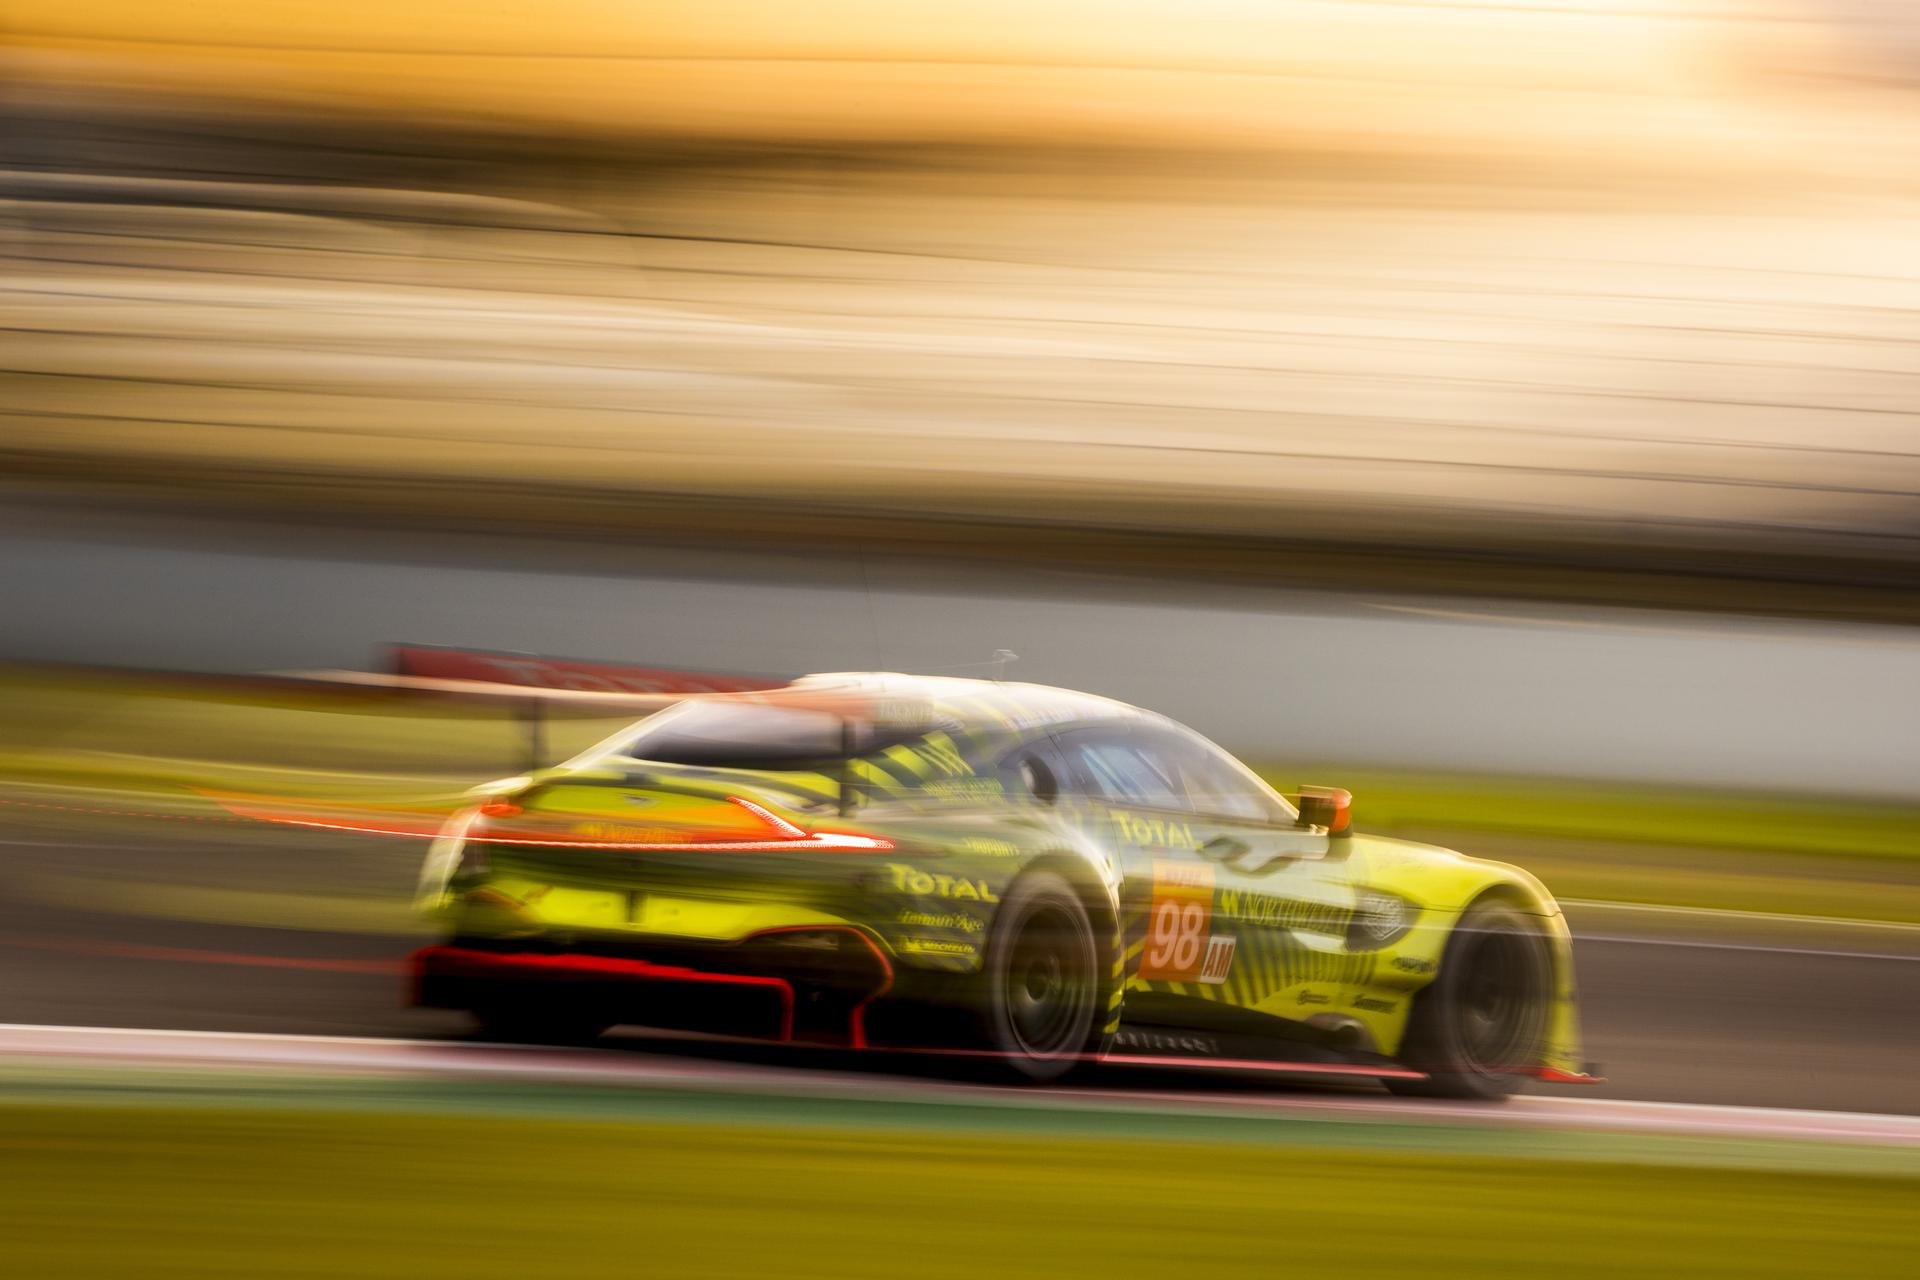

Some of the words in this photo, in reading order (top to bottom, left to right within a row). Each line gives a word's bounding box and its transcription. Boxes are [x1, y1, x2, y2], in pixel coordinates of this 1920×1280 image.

[1109, 809, 1204, 852] TOTAL
[887, 863, 999, 904] TOTAL
[1150, 899, 1204, 971] 98
[1203, 942, 1235, 978] AM
